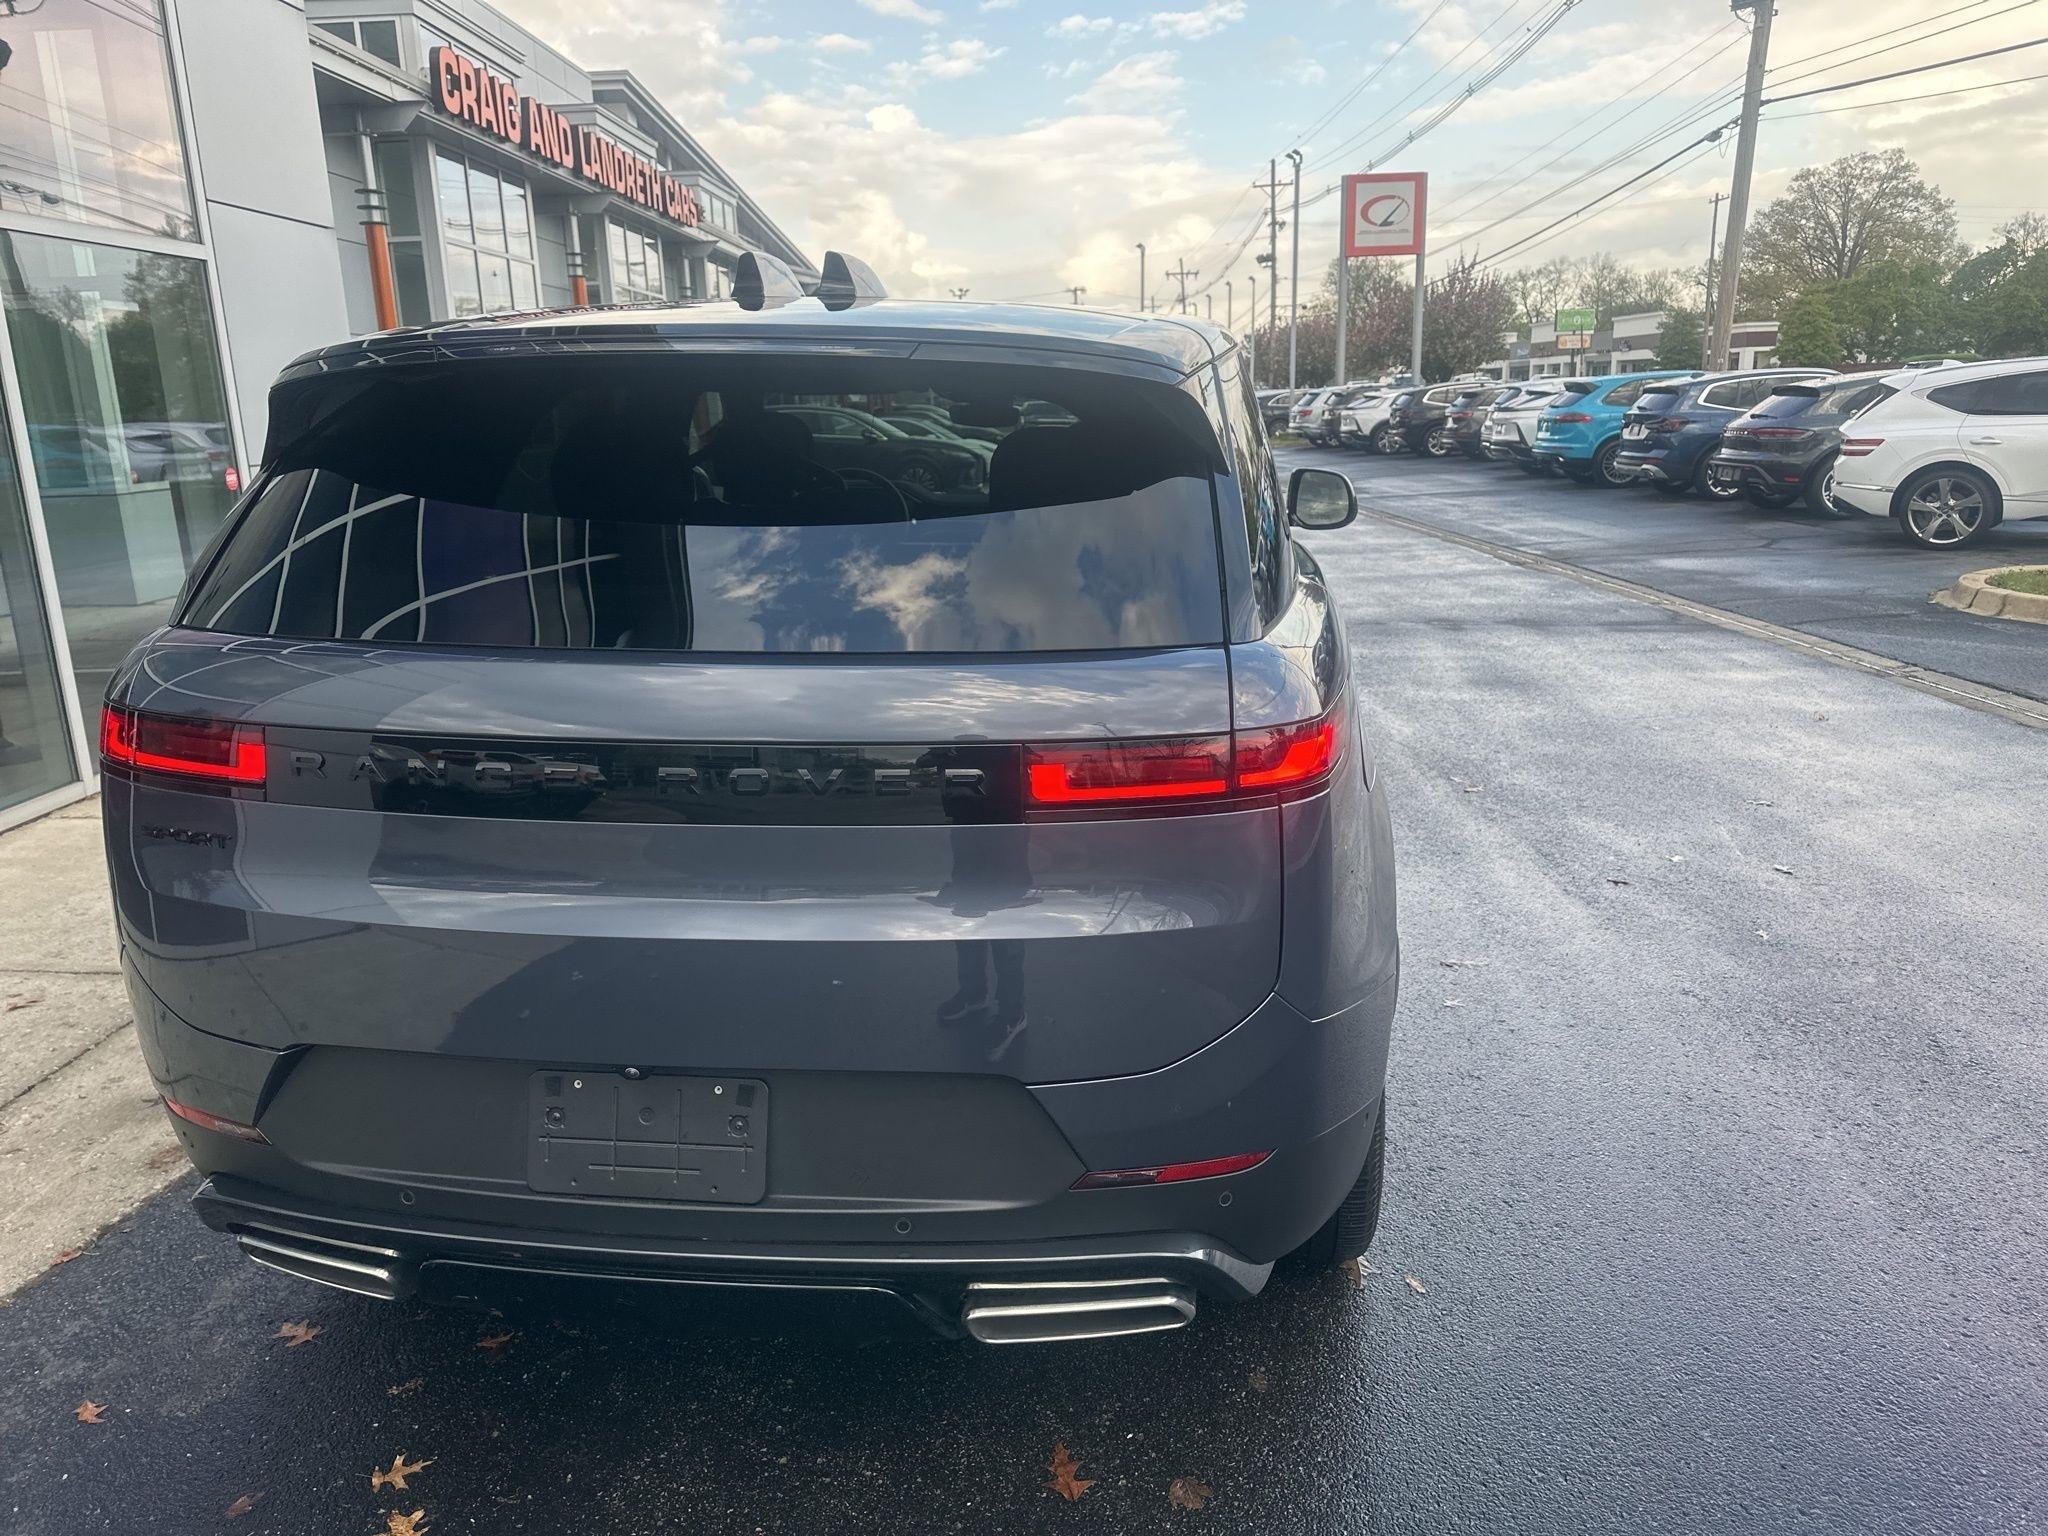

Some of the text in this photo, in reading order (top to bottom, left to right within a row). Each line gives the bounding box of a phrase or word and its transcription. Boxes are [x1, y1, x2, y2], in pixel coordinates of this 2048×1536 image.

[437, 46, 698, 228] CRAIG AND LANDRETH CARS
[289, 750, 987, 797] RANGE ROVER
